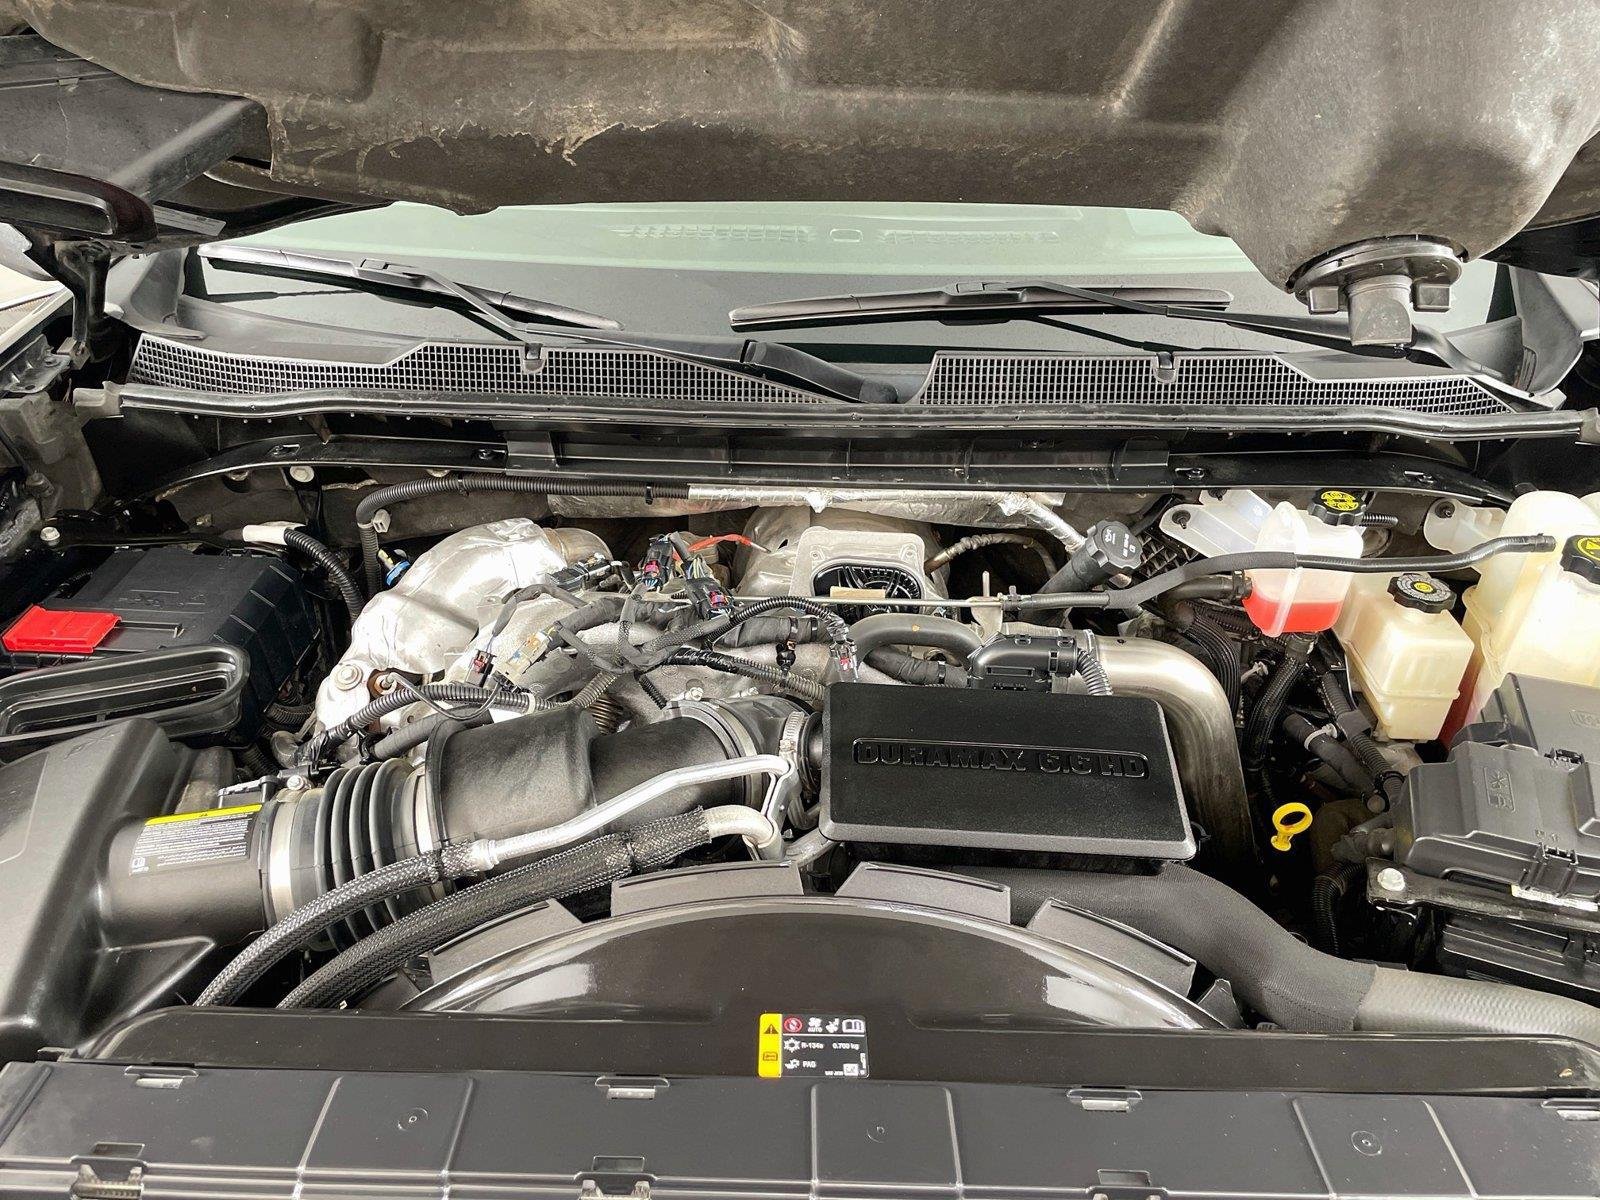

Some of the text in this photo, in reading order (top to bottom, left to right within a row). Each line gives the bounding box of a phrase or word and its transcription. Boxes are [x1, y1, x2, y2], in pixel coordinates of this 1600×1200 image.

[856, 743, 1148, 779] DURAMAX 6.6 HD
